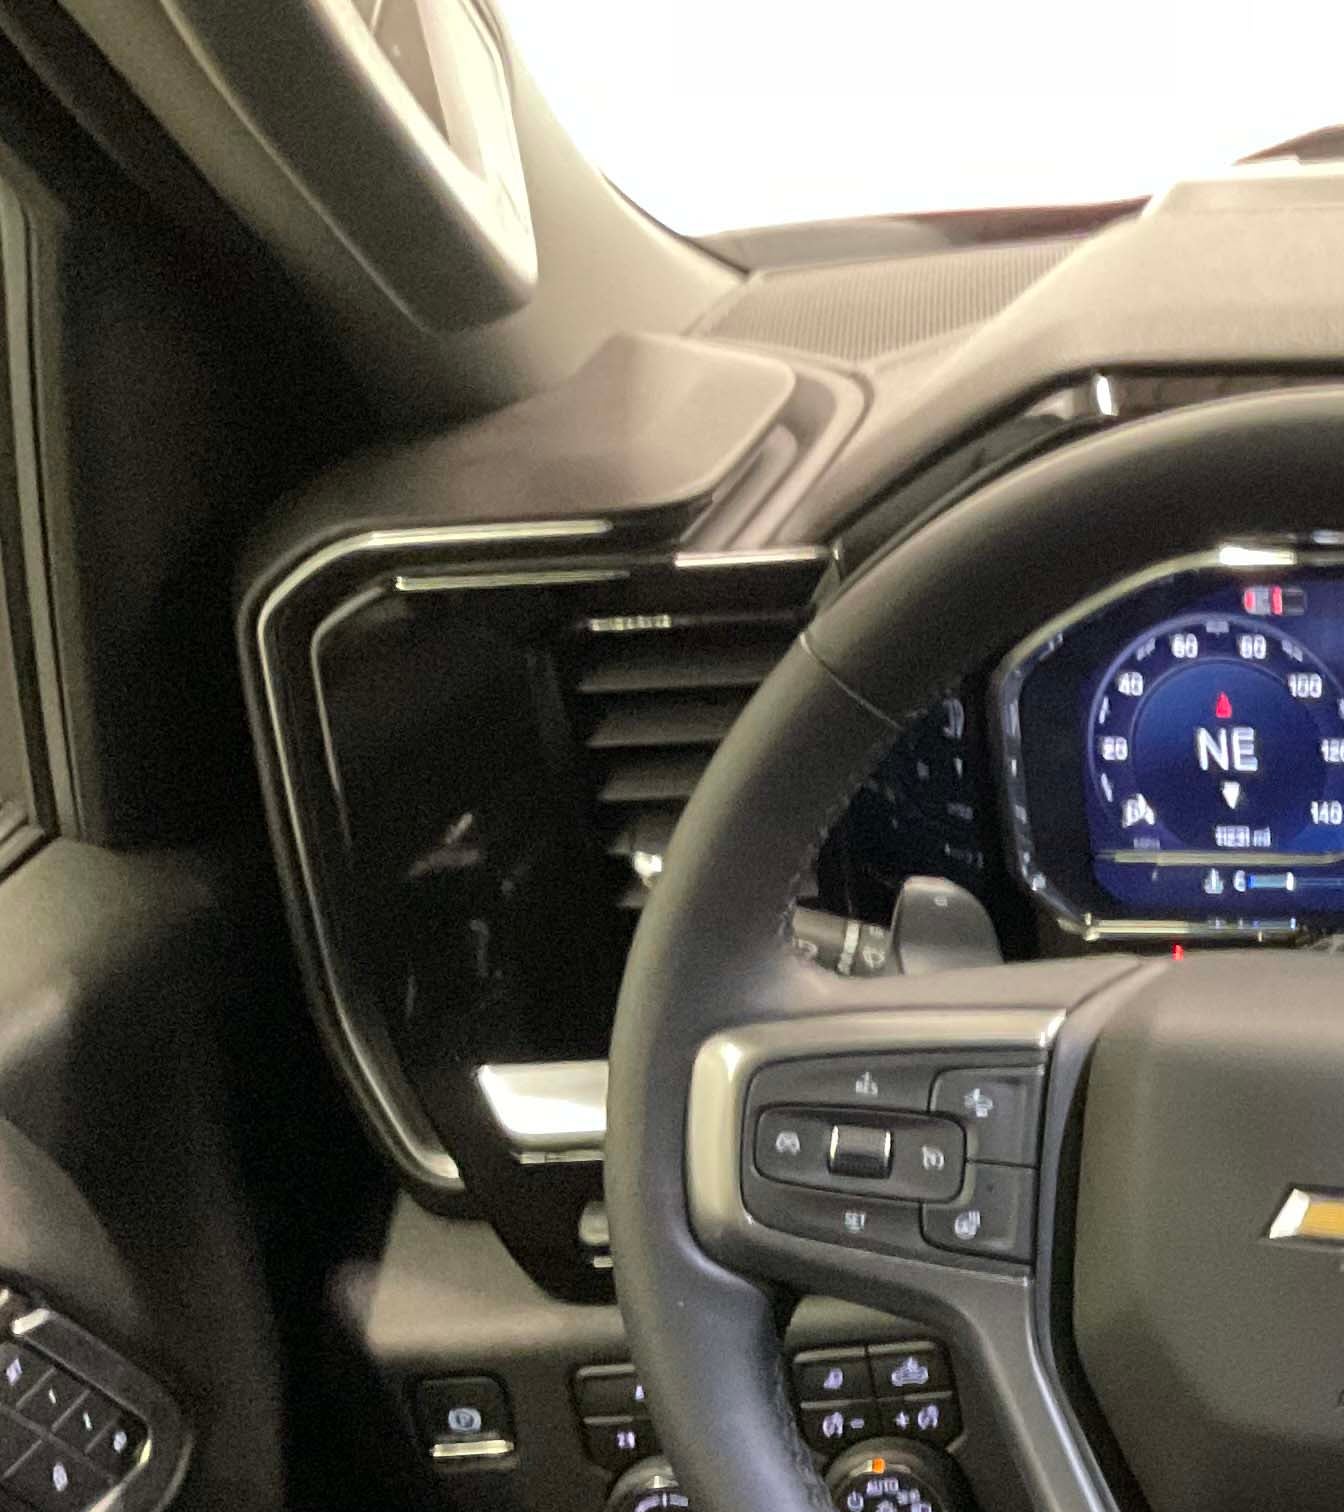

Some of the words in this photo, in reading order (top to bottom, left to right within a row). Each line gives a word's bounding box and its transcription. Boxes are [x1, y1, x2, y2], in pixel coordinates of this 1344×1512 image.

[1288, 673, 1323, 698] 100
[1198, 726, 1259, 772] NE
[1311, 800, 1344, 825] 140
